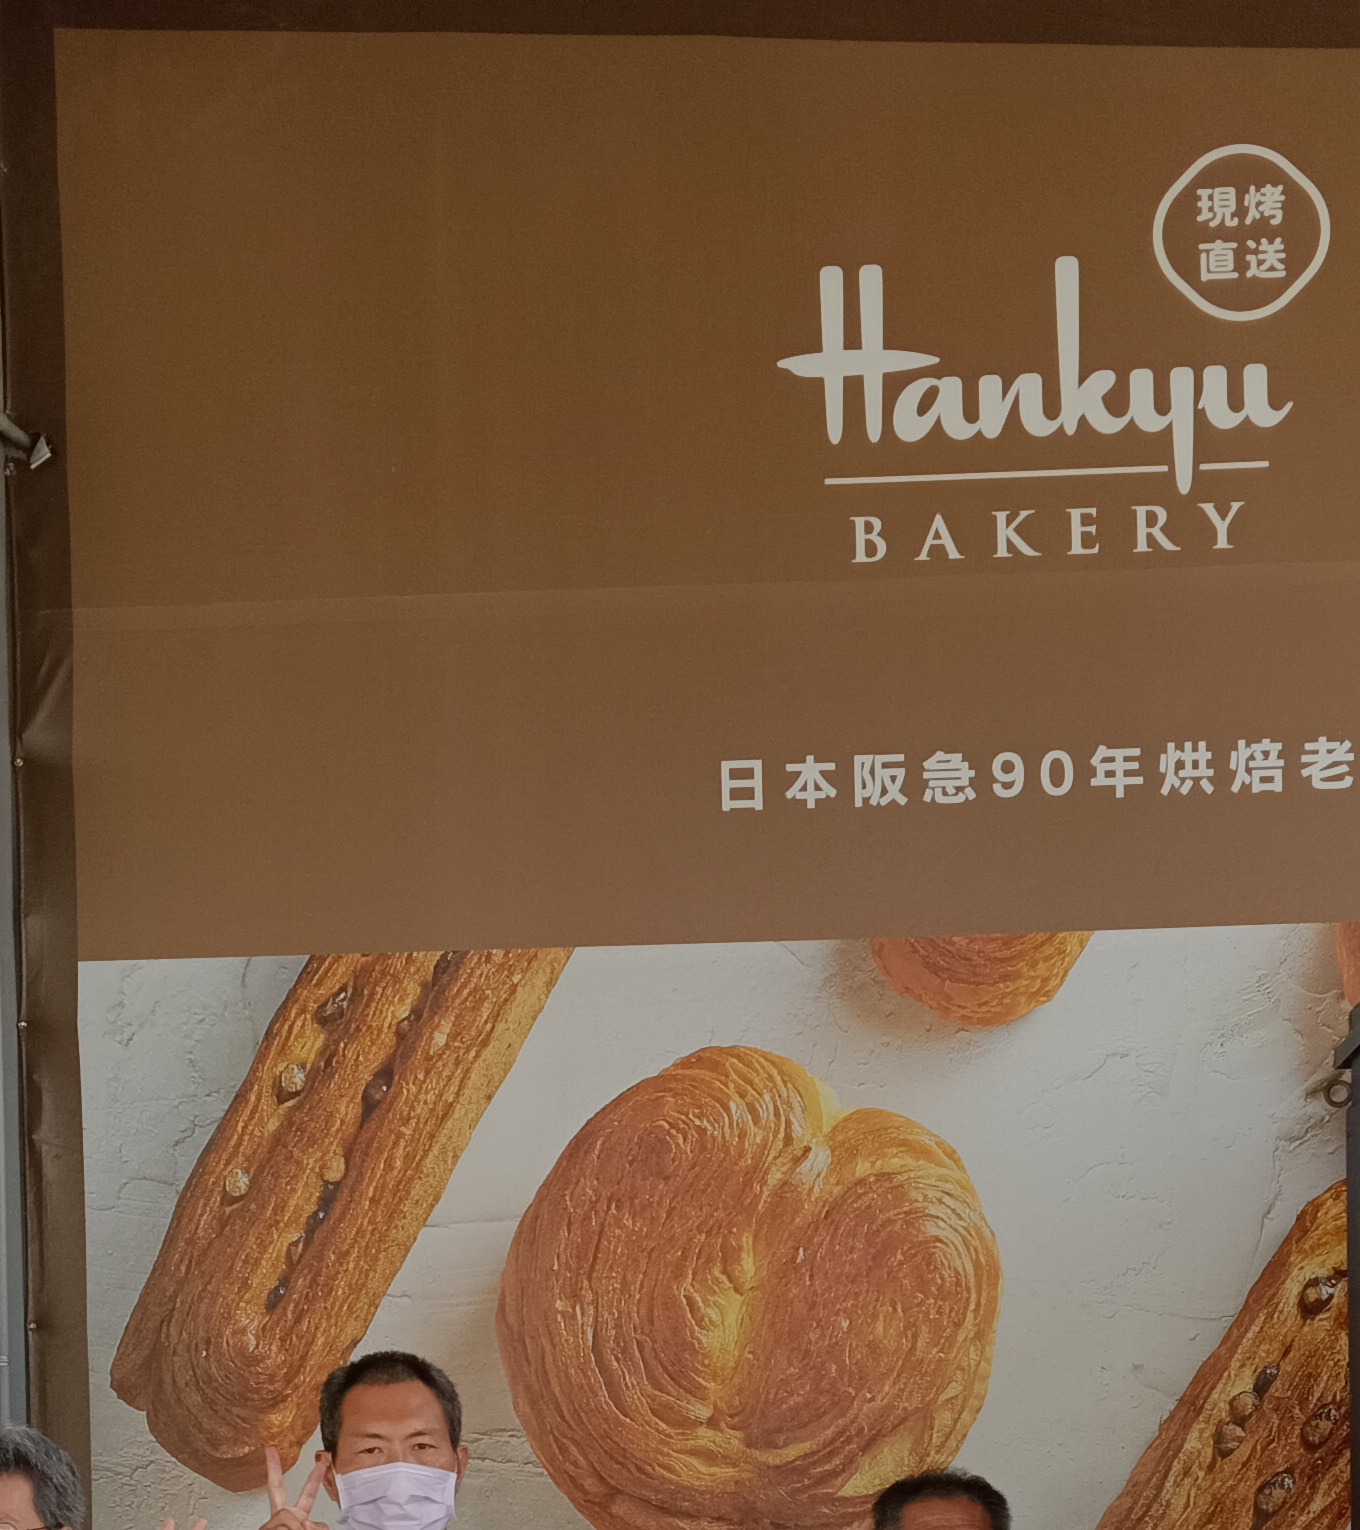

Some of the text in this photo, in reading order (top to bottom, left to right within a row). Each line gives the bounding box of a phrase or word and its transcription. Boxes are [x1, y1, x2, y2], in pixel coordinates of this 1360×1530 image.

[1196, 184, 1286, 228] 現烤
[1198, 237, 1287, 282] 直送
[776, 255, 1293, 495] Hankyu
[850, 501, 1245, 563] BAKERY
